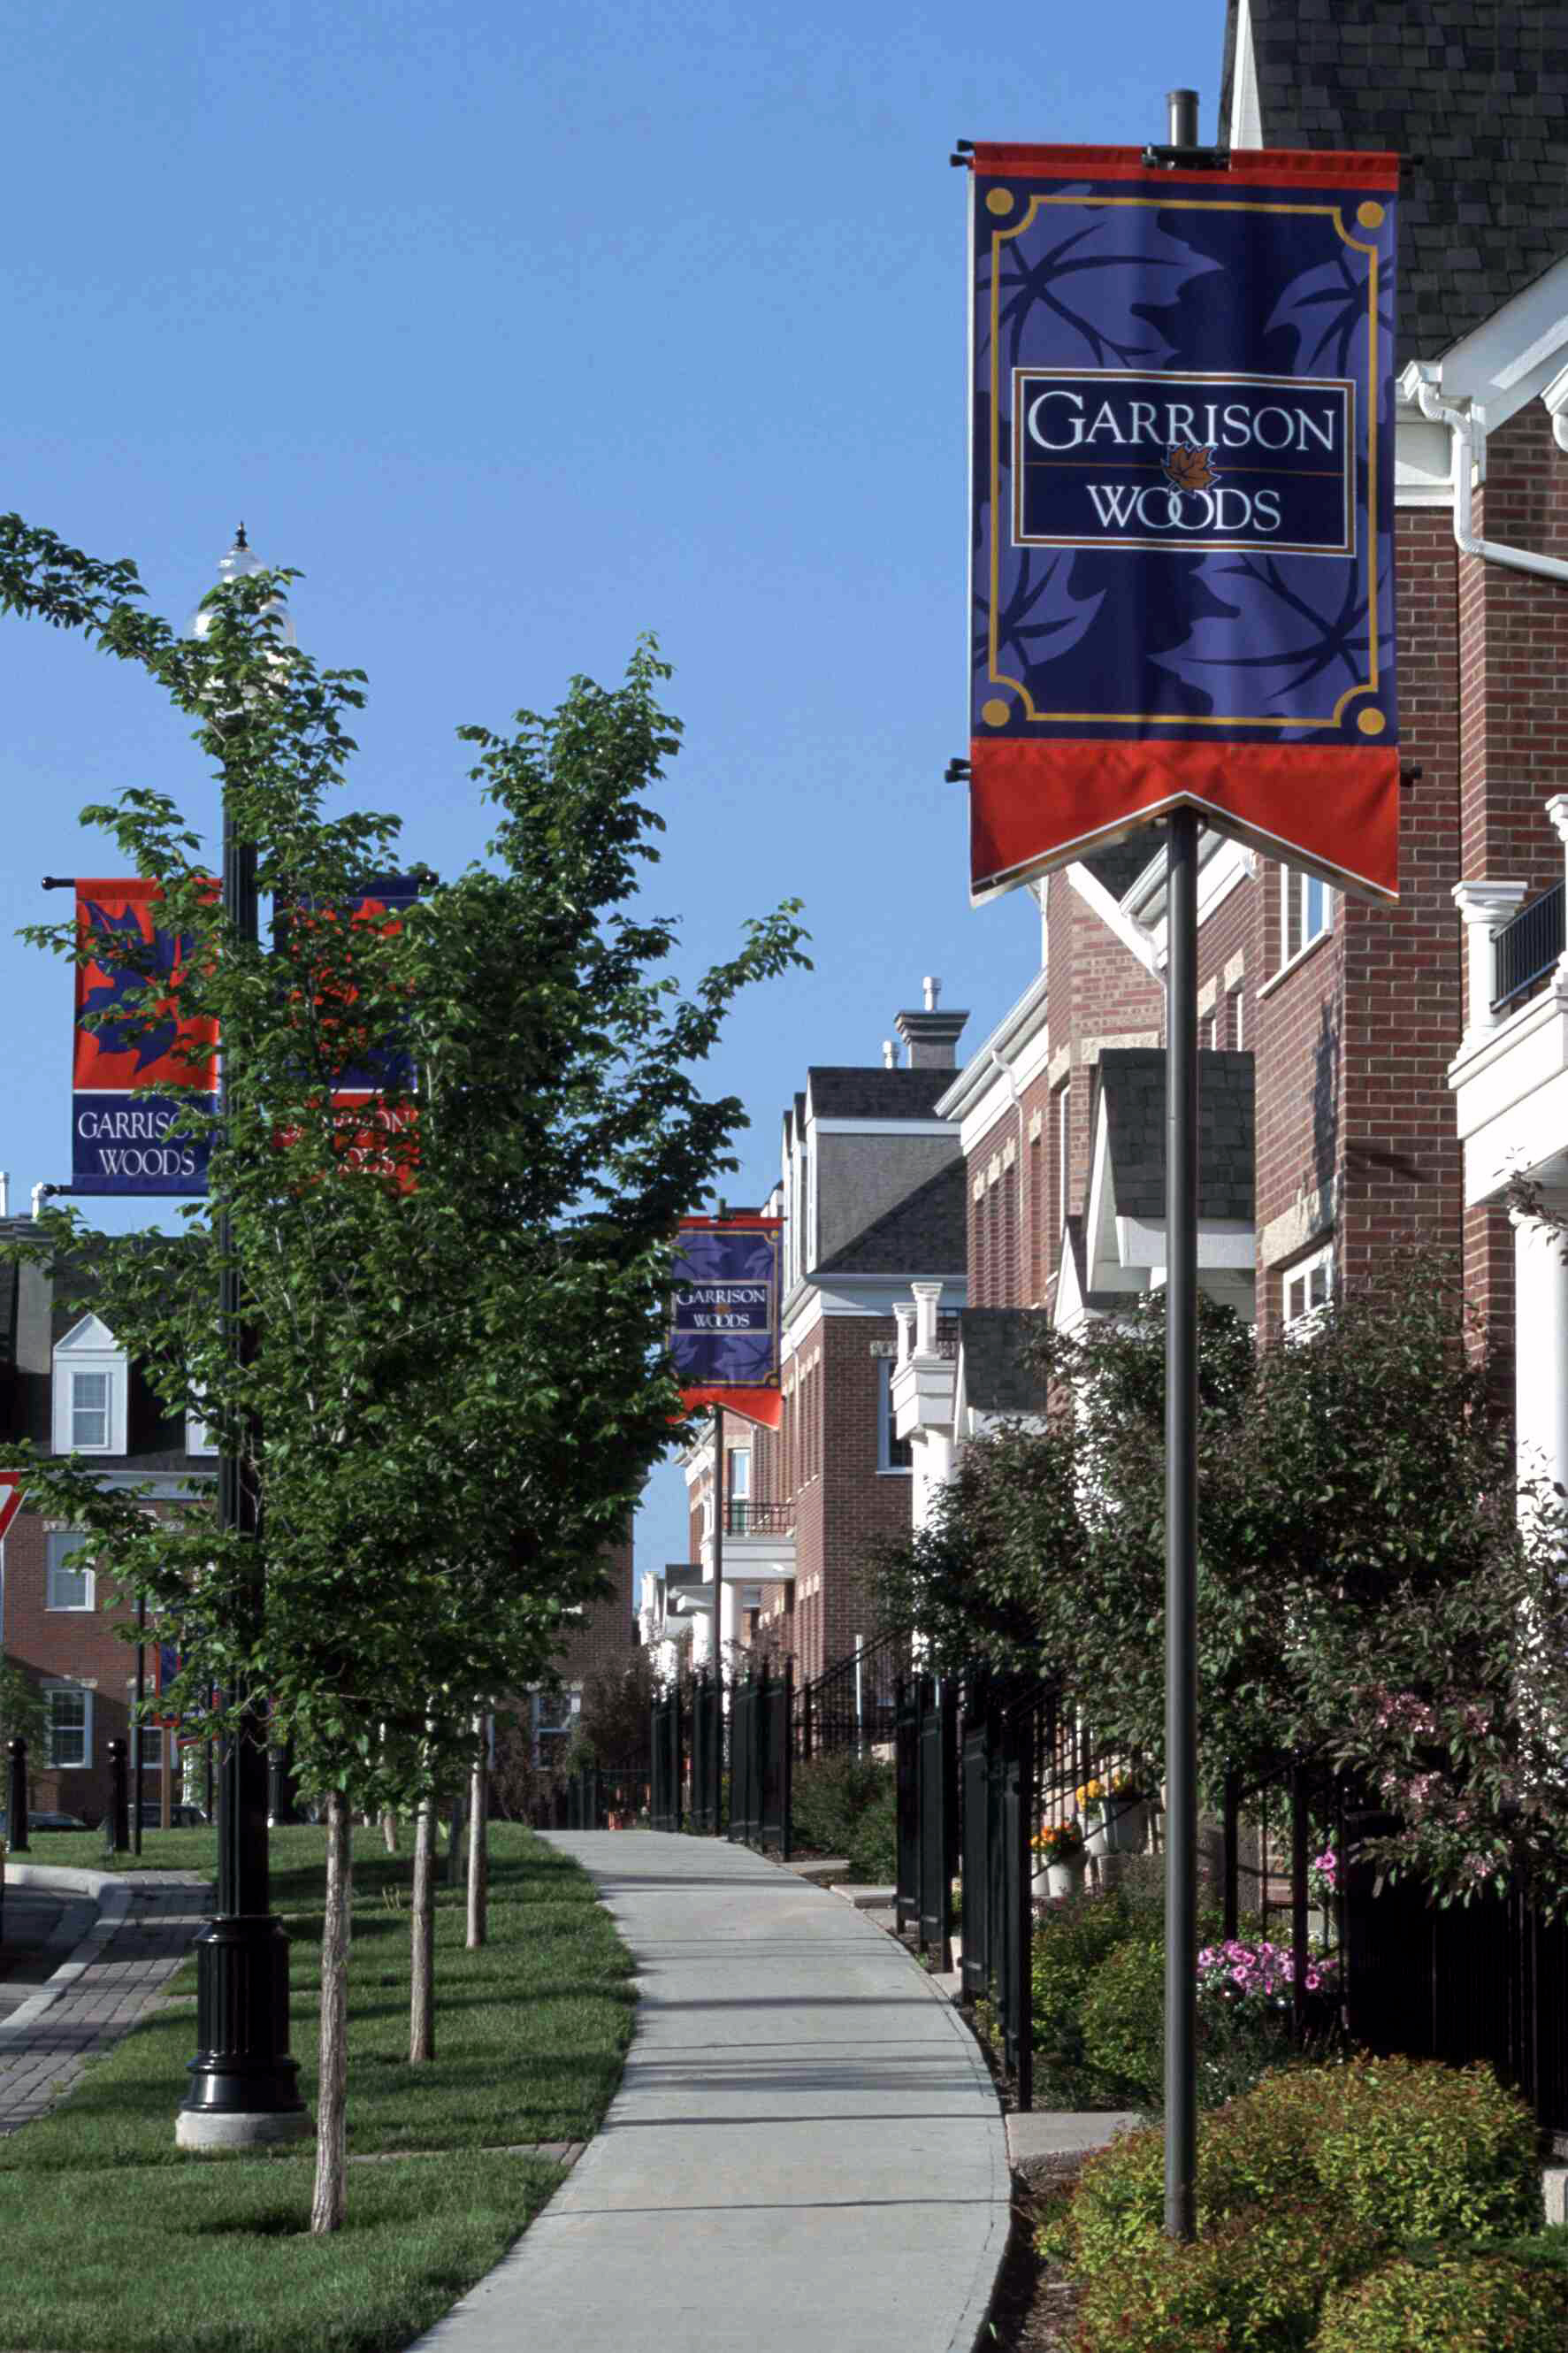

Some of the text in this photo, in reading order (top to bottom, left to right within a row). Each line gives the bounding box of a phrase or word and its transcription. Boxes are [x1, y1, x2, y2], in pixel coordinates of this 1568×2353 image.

[1027, 390, 1335, 451] GARRISON
[1086, 484, 1281, 532] WOODS
[78, 1111, 209, 1139] GARRIS
[99, 1148, 195, 1176] WOODS
[692, 1314, 751, 1328] WOODS
